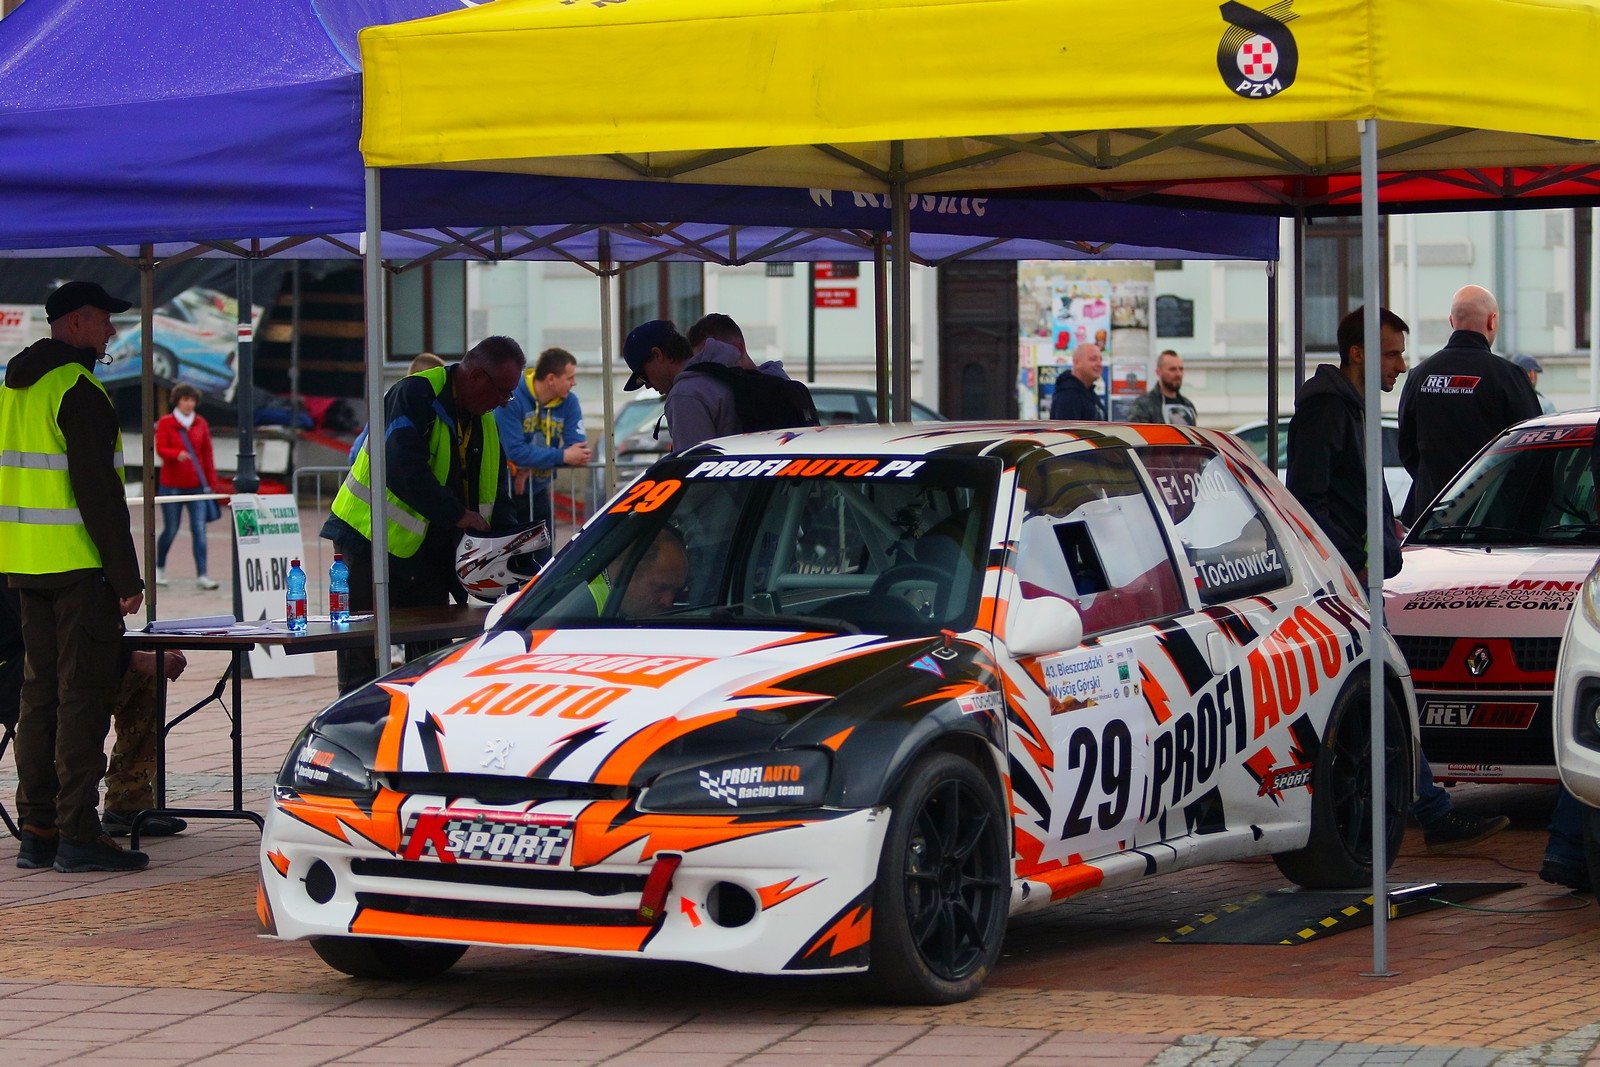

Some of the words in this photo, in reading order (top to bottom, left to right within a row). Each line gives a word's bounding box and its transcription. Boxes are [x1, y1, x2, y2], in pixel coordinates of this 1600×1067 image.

[1236, 77, 1282, 97] PZM
[608, 479, 682, 514] 29
[1157, 470, 1228, 507] E1-2000
[246, 557, 264, 592] OA
[1196, 547, 1282, 589] Tochowicz
[495, 655, 702, 675] PROFI
[1045, 665, 1058, 679] 43.
[1057, 655, 1103, 677] Bieszczadzki
[441, 682, 633, 720] AUTO
[1076, 675, 1101, 692] Górski
[738, 786, 776, 799] Racing
[777, 785, 805, 796] team
[1060, 718, 1132, 841] 29
